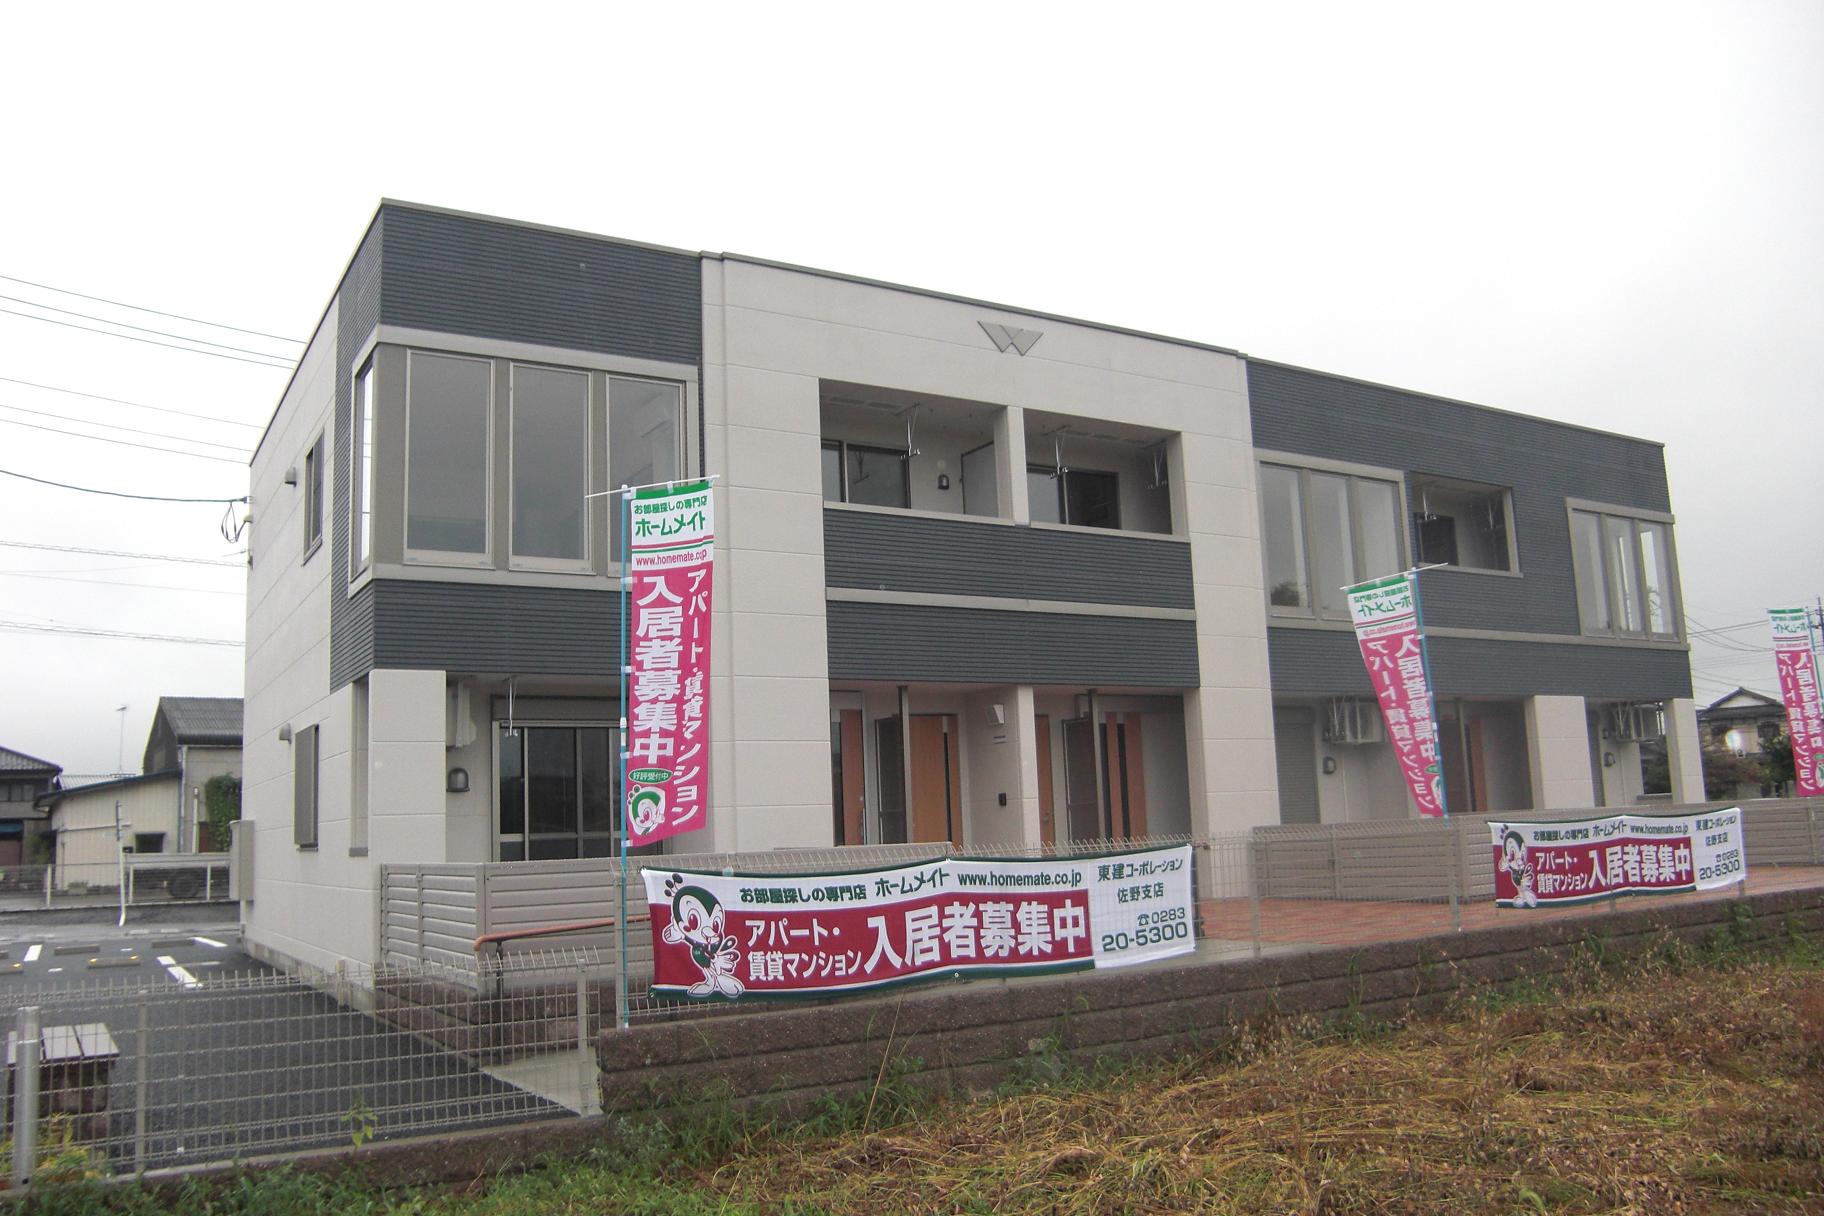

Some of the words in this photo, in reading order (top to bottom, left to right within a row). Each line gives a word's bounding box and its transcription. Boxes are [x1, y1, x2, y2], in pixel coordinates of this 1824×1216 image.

[634, 495, 708, 514] お部屋探しの専門店
[635, 510, 706, 537] ホームメイト
[632, 575, 683, 764] 入居者募集中
[672, 569, 707, 826] アパート・賃貸マンション
[1592, 820, 1627, 837] ホームメイト
[1630, 823, 1688, 835] www.homemate.co.jp
[1588, 843, 1691, 889] 入居者募集中
[1722, 849, 1739, 861] 0283
[1097, 858, 1183, 882] 東建コーポレーション
[1536, 872, 1589, 894] 賃貸マンション
[1699, 860, 1740, 880] 20-5300
[739, 883, 867, 904] お部屋探しの専門店
[875, 867, 951, 898] ホームメイト
[957, 869, 1082, 888] www.homemate.co.jp
[1117, 881, 1164, 904] 佐野支店
[1151, 907, 1186, 925] 0283
[745, 918, 841, 947] アパート・
[863, 898, 1087, 975] 入居者募集中
[1101, 921, 1188, 952] 20-5300
[747, 949, 862, 982] 賃貸マンション
